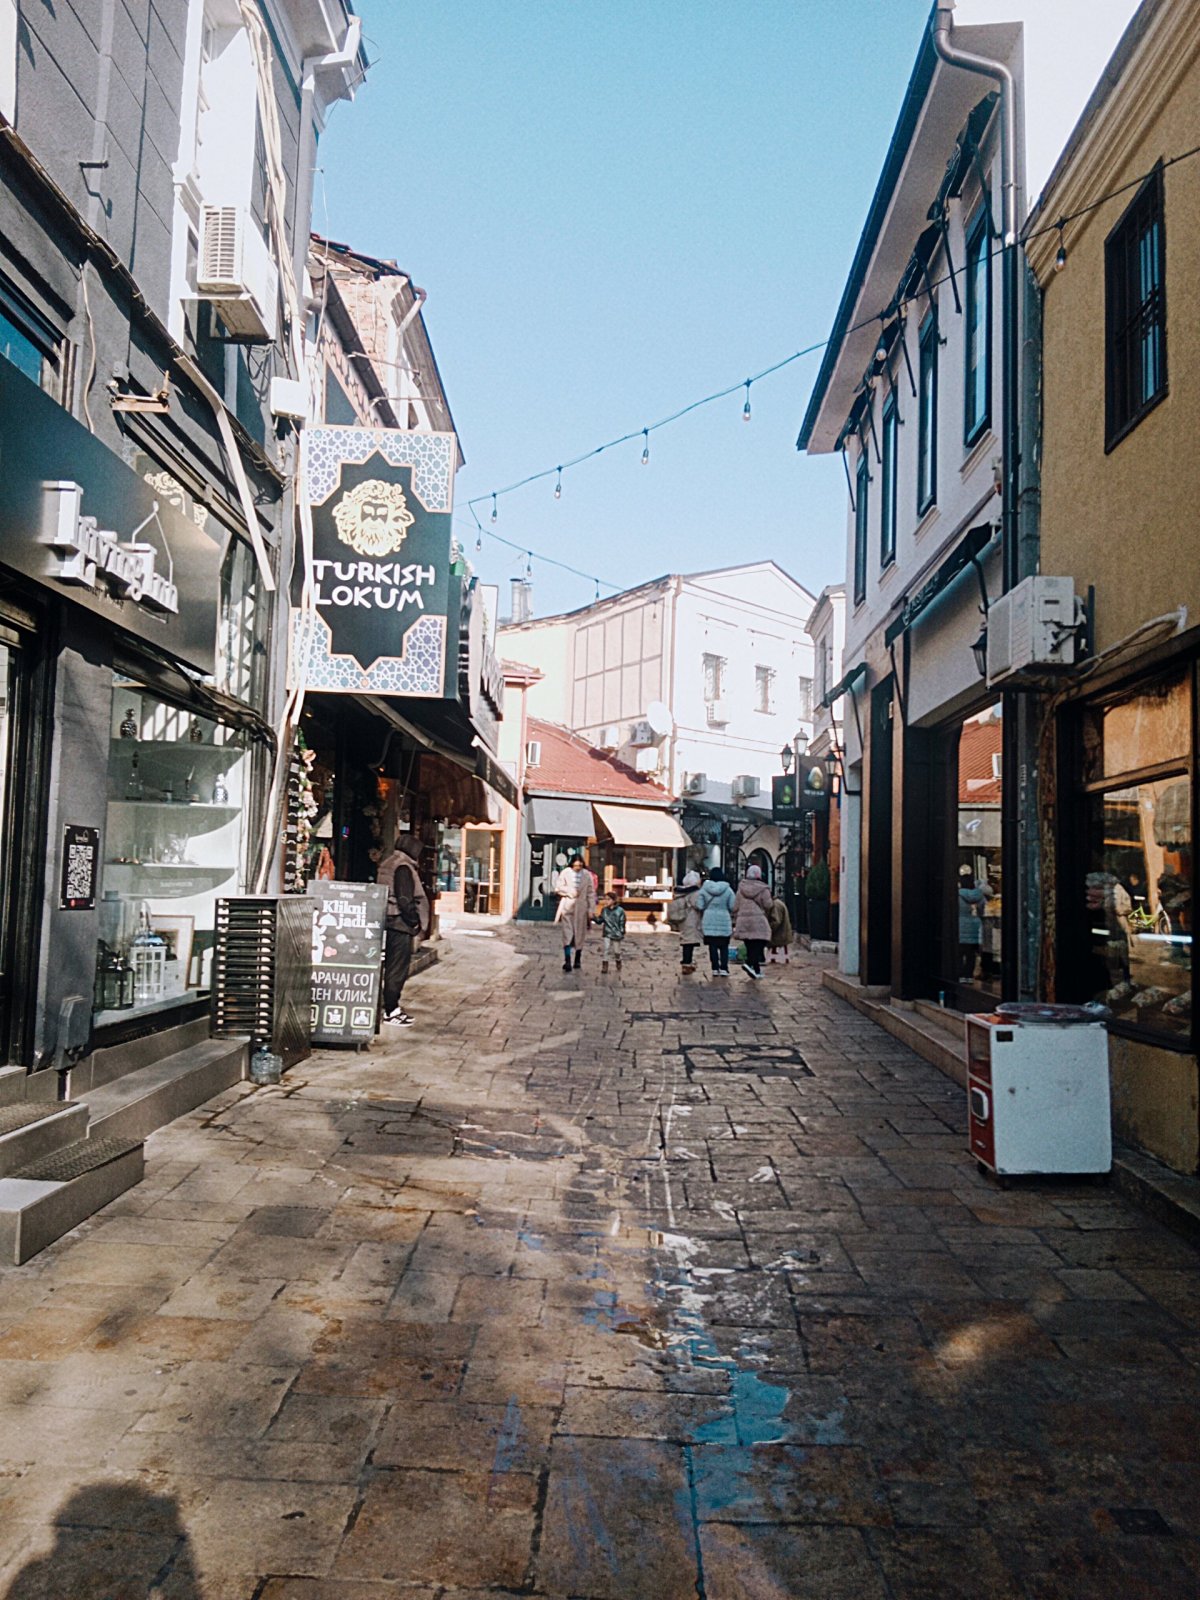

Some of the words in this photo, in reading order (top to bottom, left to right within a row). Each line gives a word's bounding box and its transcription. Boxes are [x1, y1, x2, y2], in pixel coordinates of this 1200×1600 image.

[313, 559, 436, 586] TURKISH
[314, 585, 425, 612] LOKUM
[322, 899, 367, 914] Klikni
[310, 971, 351, 987] АРАЧАЈ
[352, 973, 370, 987] СО
